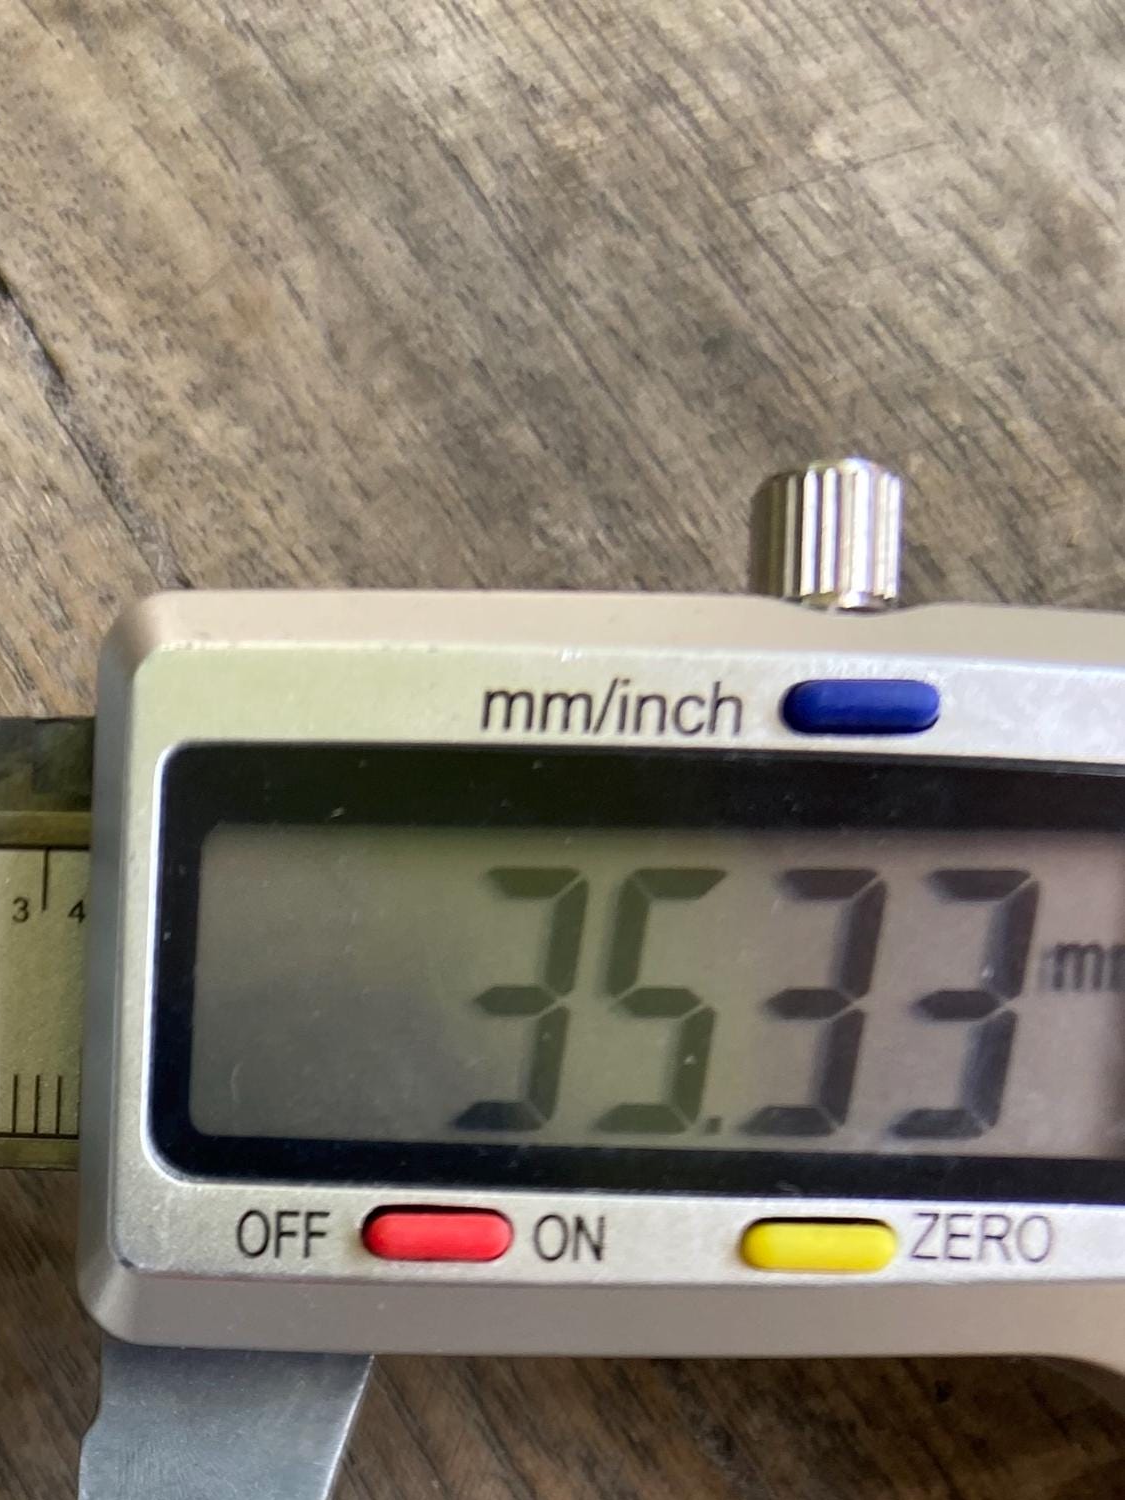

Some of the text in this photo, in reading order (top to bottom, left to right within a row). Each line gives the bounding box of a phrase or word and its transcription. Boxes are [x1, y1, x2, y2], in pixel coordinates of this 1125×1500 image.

[481, 677, 744, 736] mm/inch
[11, 896, 30, 923] 3
[68, 899, 87, 924] 4
[450, 866, 1041, 1140] 35.33
[235, 1210, 1054, 1264] OFF ON ZERO
